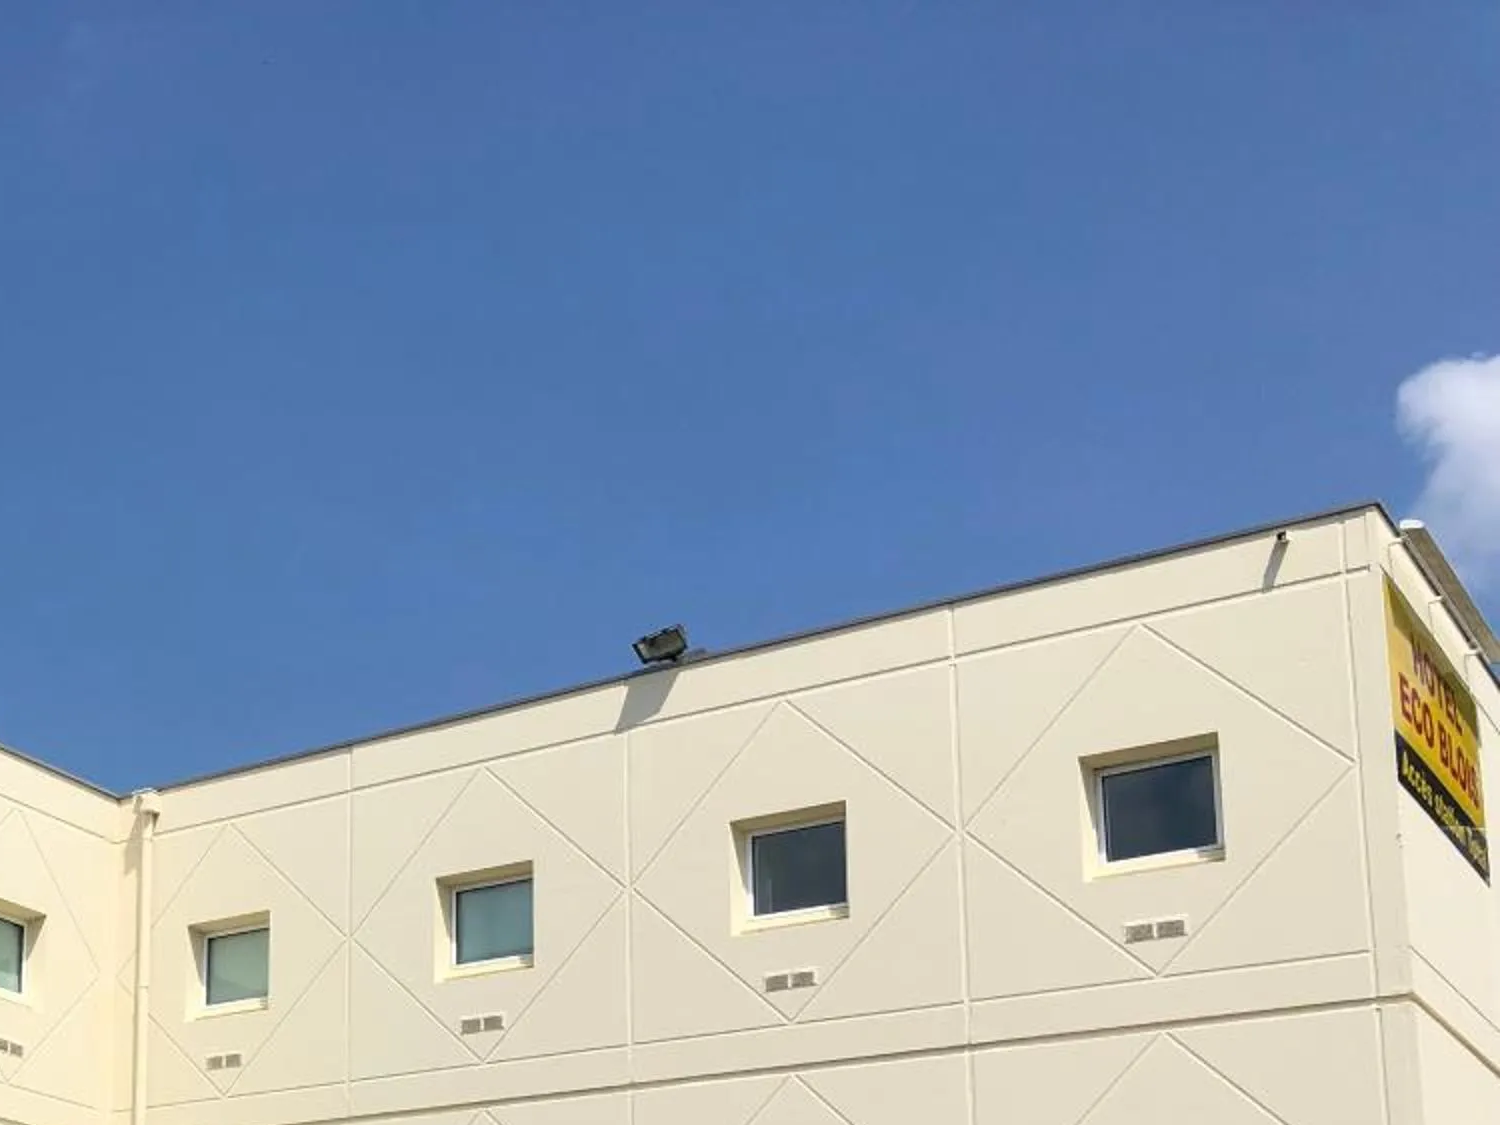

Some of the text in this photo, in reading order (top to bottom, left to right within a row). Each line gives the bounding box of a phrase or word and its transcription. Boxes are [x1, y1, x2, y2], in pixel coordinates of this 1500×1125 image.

[1399, 671, 1435, 749] ECO
[1437, 719, 1479, 809] BLOIS
[1411, 630, 1463, 737] HOTEL
